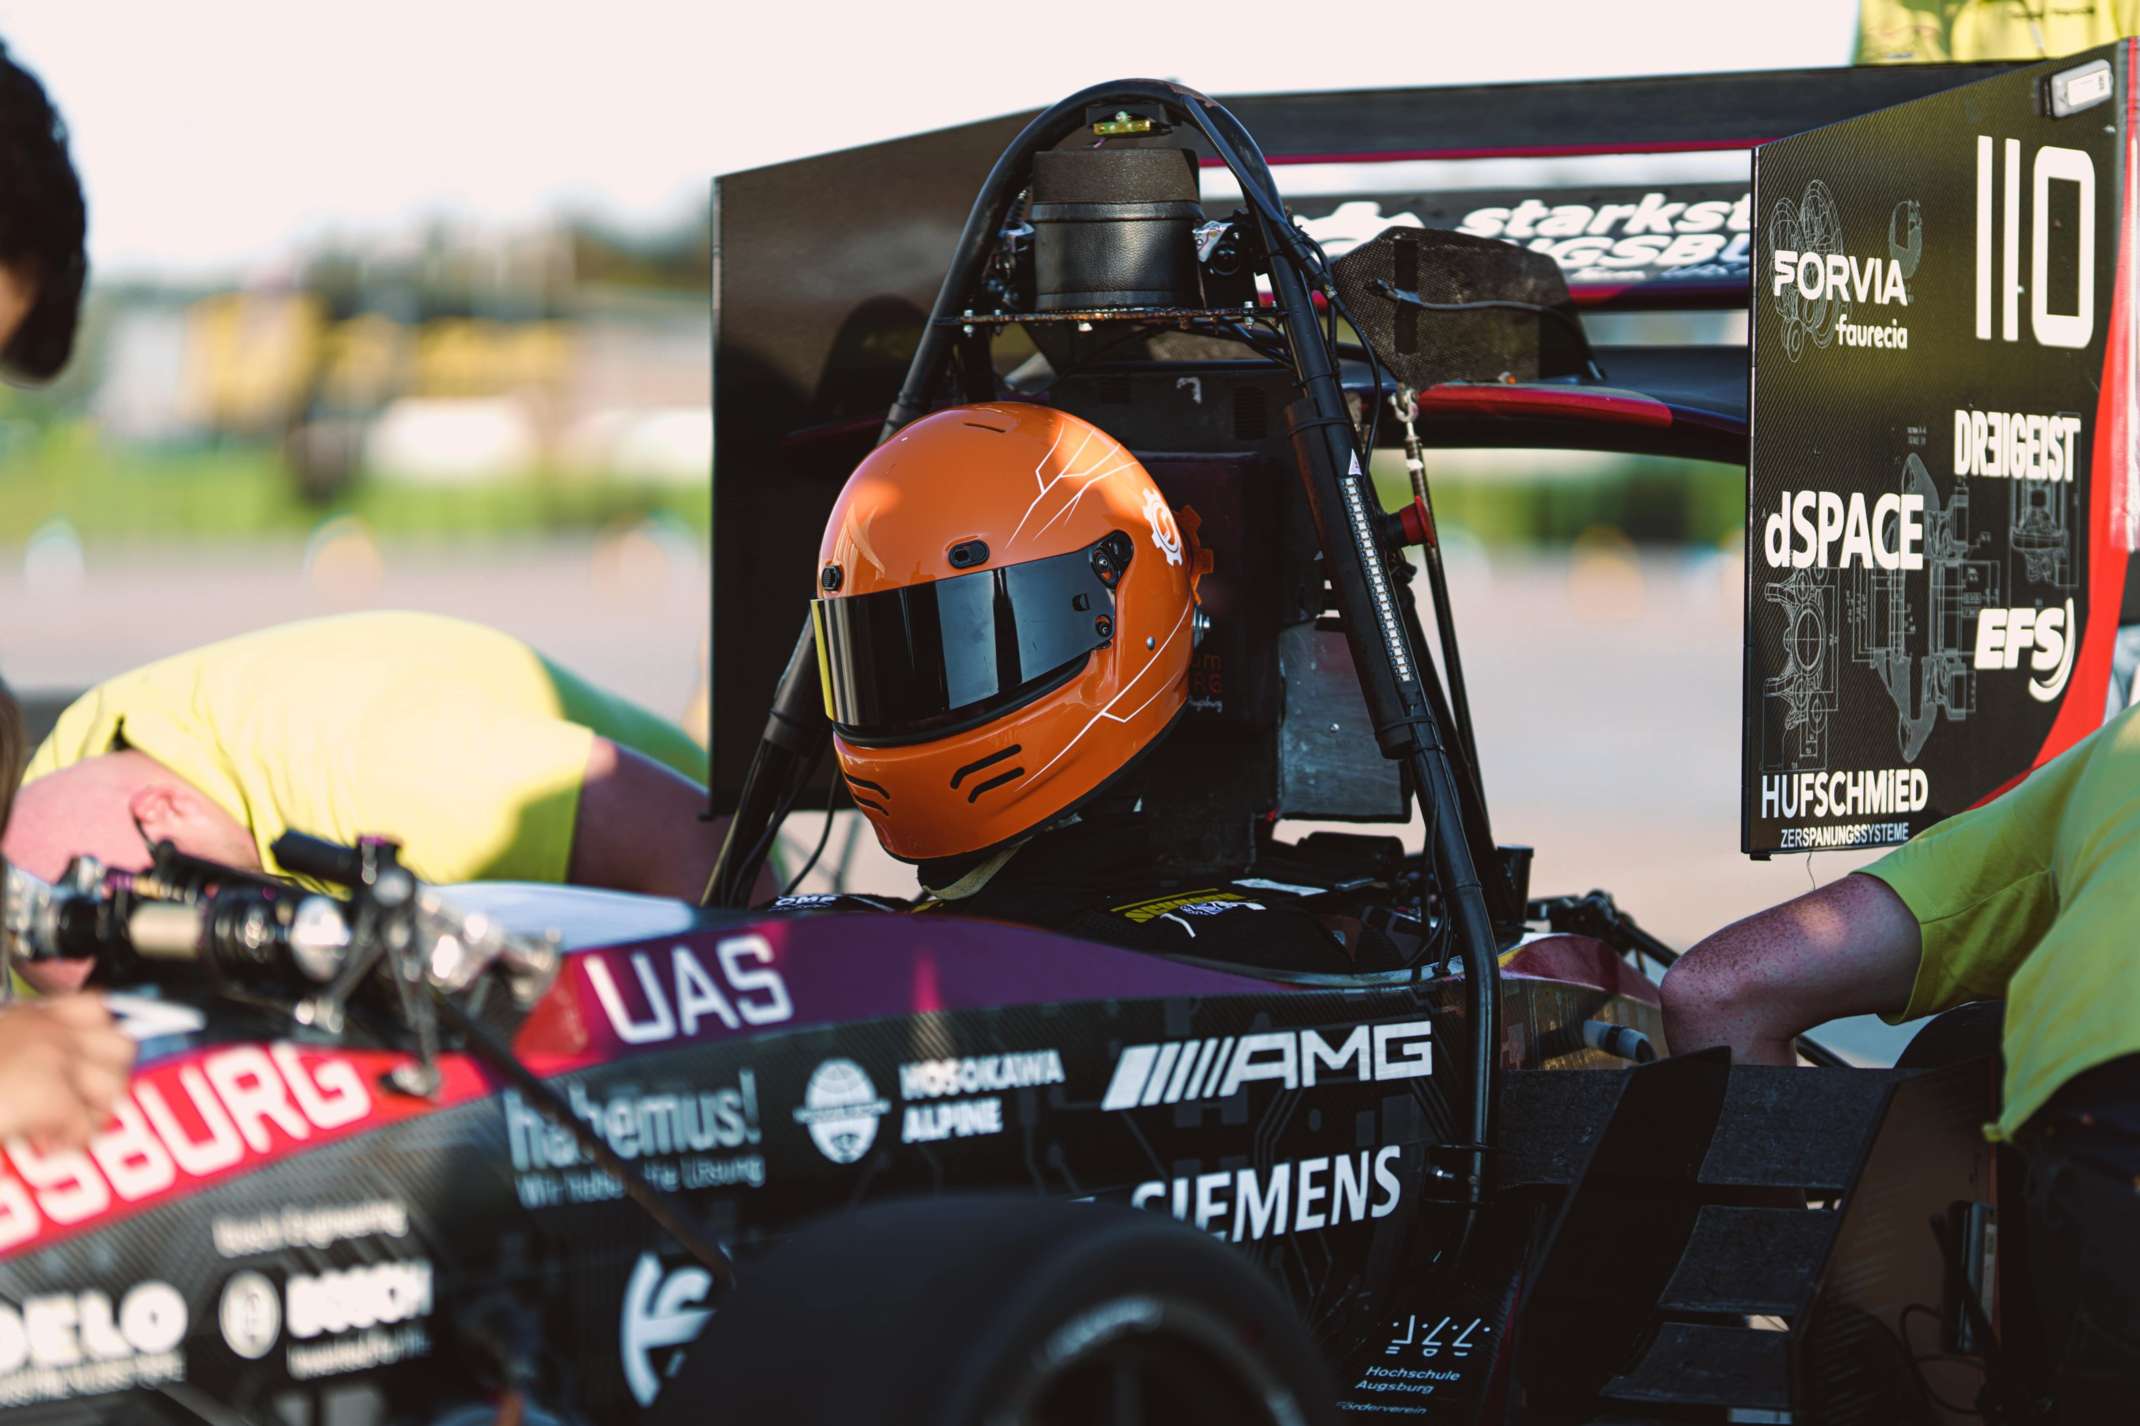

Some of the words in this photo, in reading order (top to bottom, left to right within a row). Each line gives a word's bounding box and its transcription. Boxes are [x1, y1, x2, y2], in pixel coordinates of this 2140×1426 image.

[1976, 135, 2095, 349] 110
[1773, 250, 1908, 306] FORVIA
[1836, 314, 1908, 349] faurecia
[1764, 490, 1924, 570] dSPACE
[1974, 607, 2066, 671] EFS
[1761, 768, 1929, 819] HUFSCHMIED
[1780, 822, 1910, 848] ZERSPANUNGSSYSTEME
[584, 933, 795, 1045] UAS
[898, 1049, 1065, 1100] HOSOKAWA
[1220, 1020, 1432, 1097] AMG
[901, 1097, 1003, 1143] ALPINE
[1354, 1380, 1436, 1395] Augsburg
[1364, 1365, 1462, 1381] Hochschule
